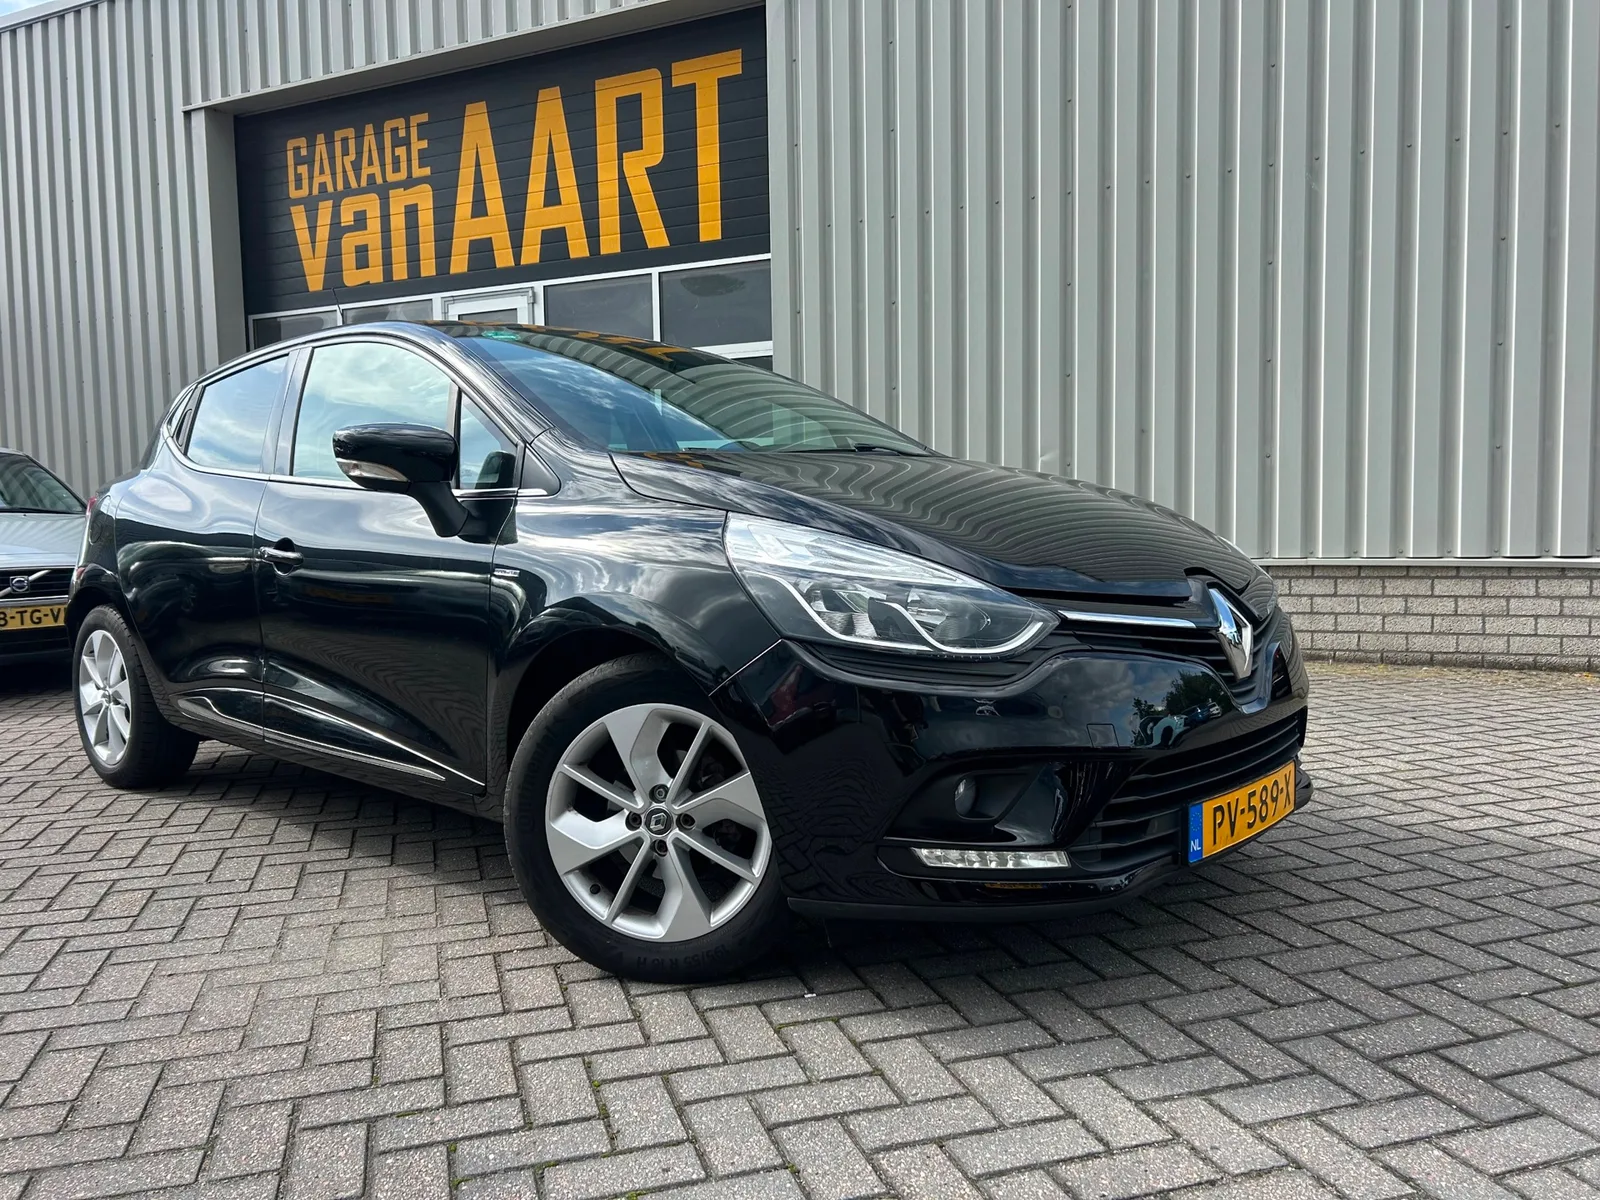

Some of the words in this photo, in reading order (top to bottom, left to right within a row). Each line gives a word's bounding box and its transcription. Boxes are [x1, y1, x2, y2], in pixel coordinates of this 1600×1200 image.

[287, 112, 431, 198] GARAGE
[289, 182, 437, 293] van
[448, 48, 743, 276] AART
[1190, 839, 1202, 853] NL
[1212, 770, 1292, 846] PV-589-X
